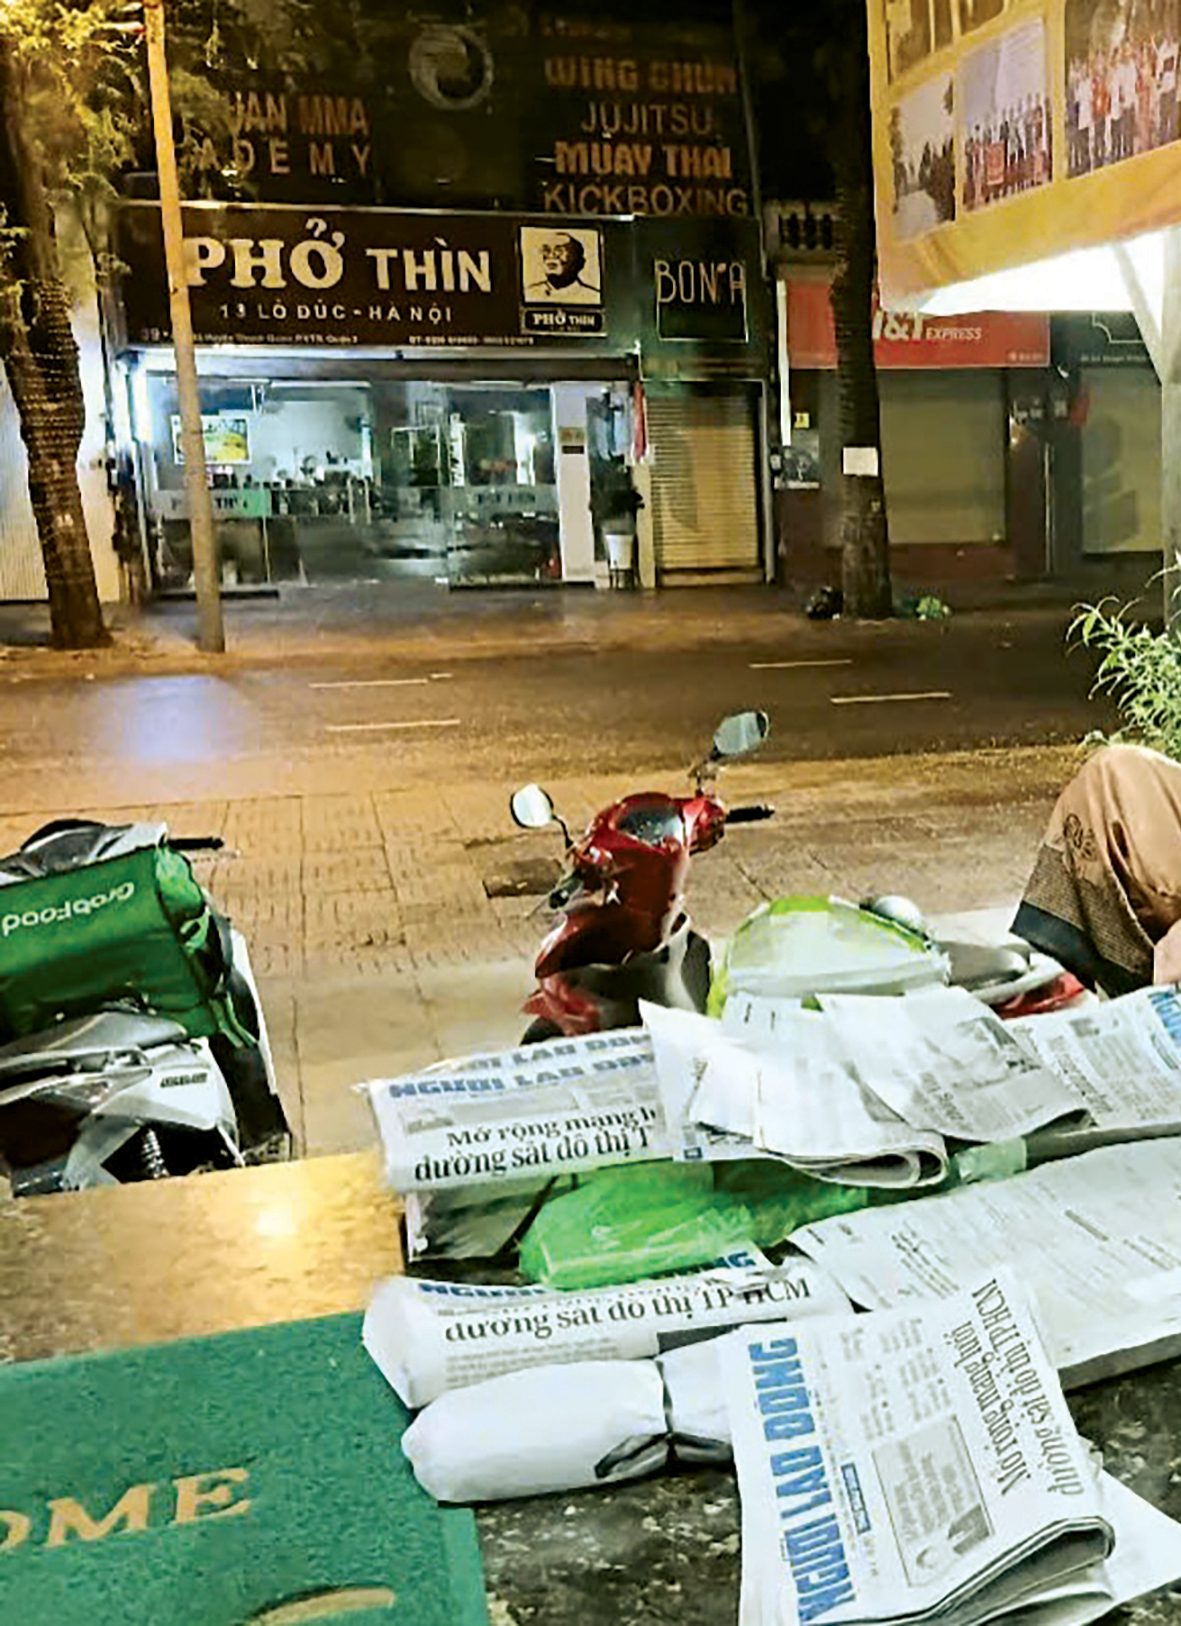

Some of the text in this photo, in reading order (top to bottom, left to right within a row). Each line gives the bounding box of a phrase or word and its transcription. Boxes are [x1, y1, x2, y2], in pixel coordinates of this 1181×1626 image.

[581, 102, 713, 135] JUJITSU
[194, 138, 370, 177] ADEMY
[555, 140, 732, 178] MUAY THAI
[544, 184, 748, 216] KICKBOXING
[182, 217, 492, 292] PHỞ THÌN
[925, 327, 982, 341] EXPRESS
[584, 1032, 651, 1052] ĐỘN
[498, 1117, 562, 1145] rộng
[595, 1128, 631, 1158] thị
[972, 1277, 1014, 1331] HCM
[769, 1445, 833, 1520] LAO
